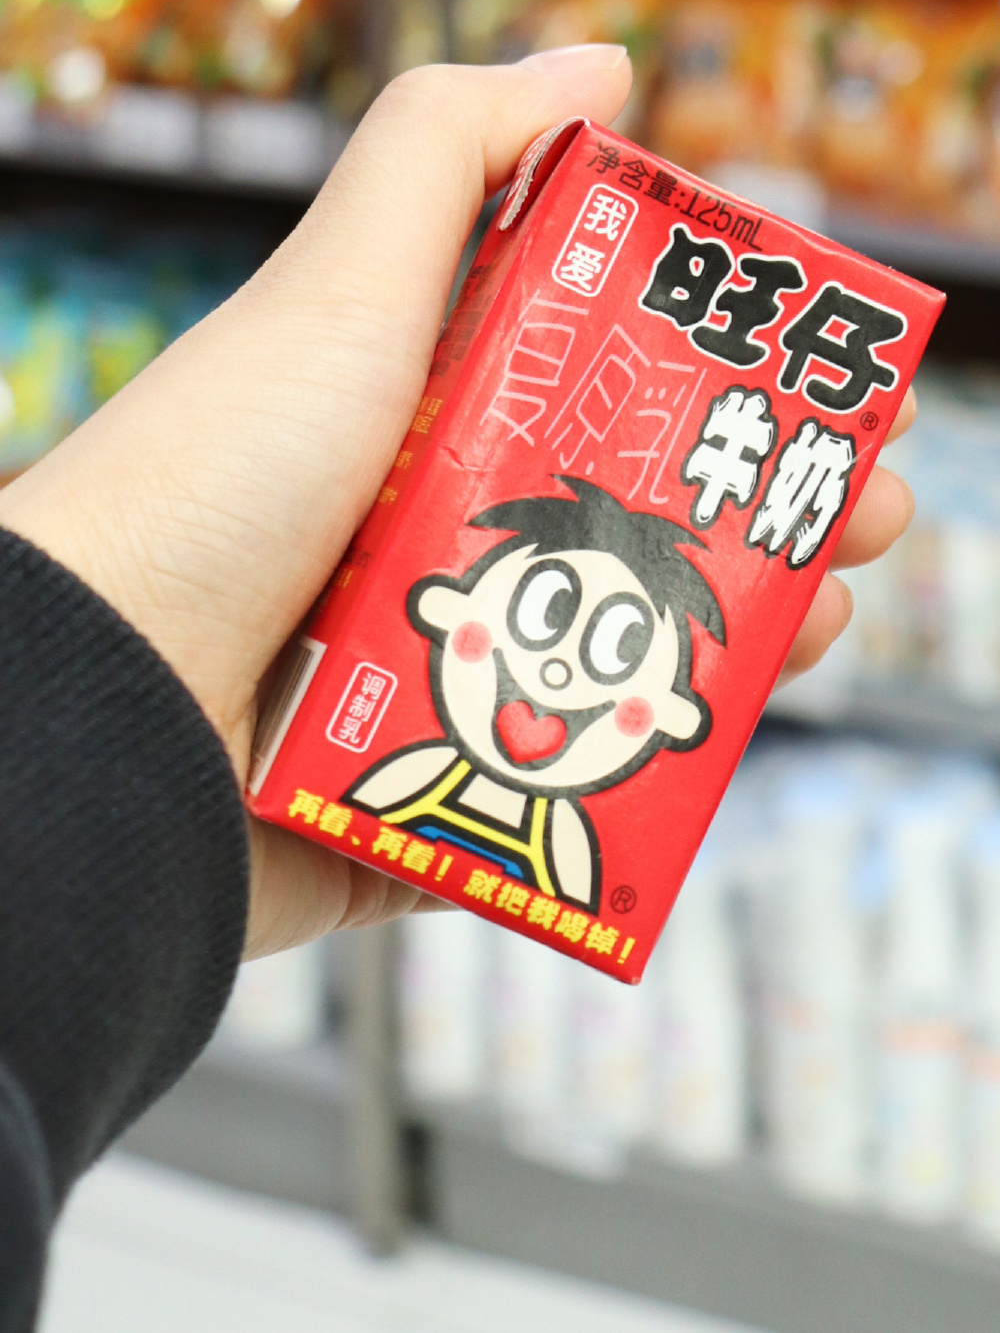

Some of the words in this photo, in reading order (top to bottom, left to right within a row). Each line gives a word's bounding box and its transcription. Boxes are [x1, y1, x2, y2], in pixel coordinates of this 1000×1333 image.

[559, 193, 628, 293] 我爱
[587, 141, 763, 252] 净含量:125mL
[638, 222, 908, 414] 旺仔
[681, 384, 857, 569] 牛奶
[338, 672, 387, 745] 调制乳
